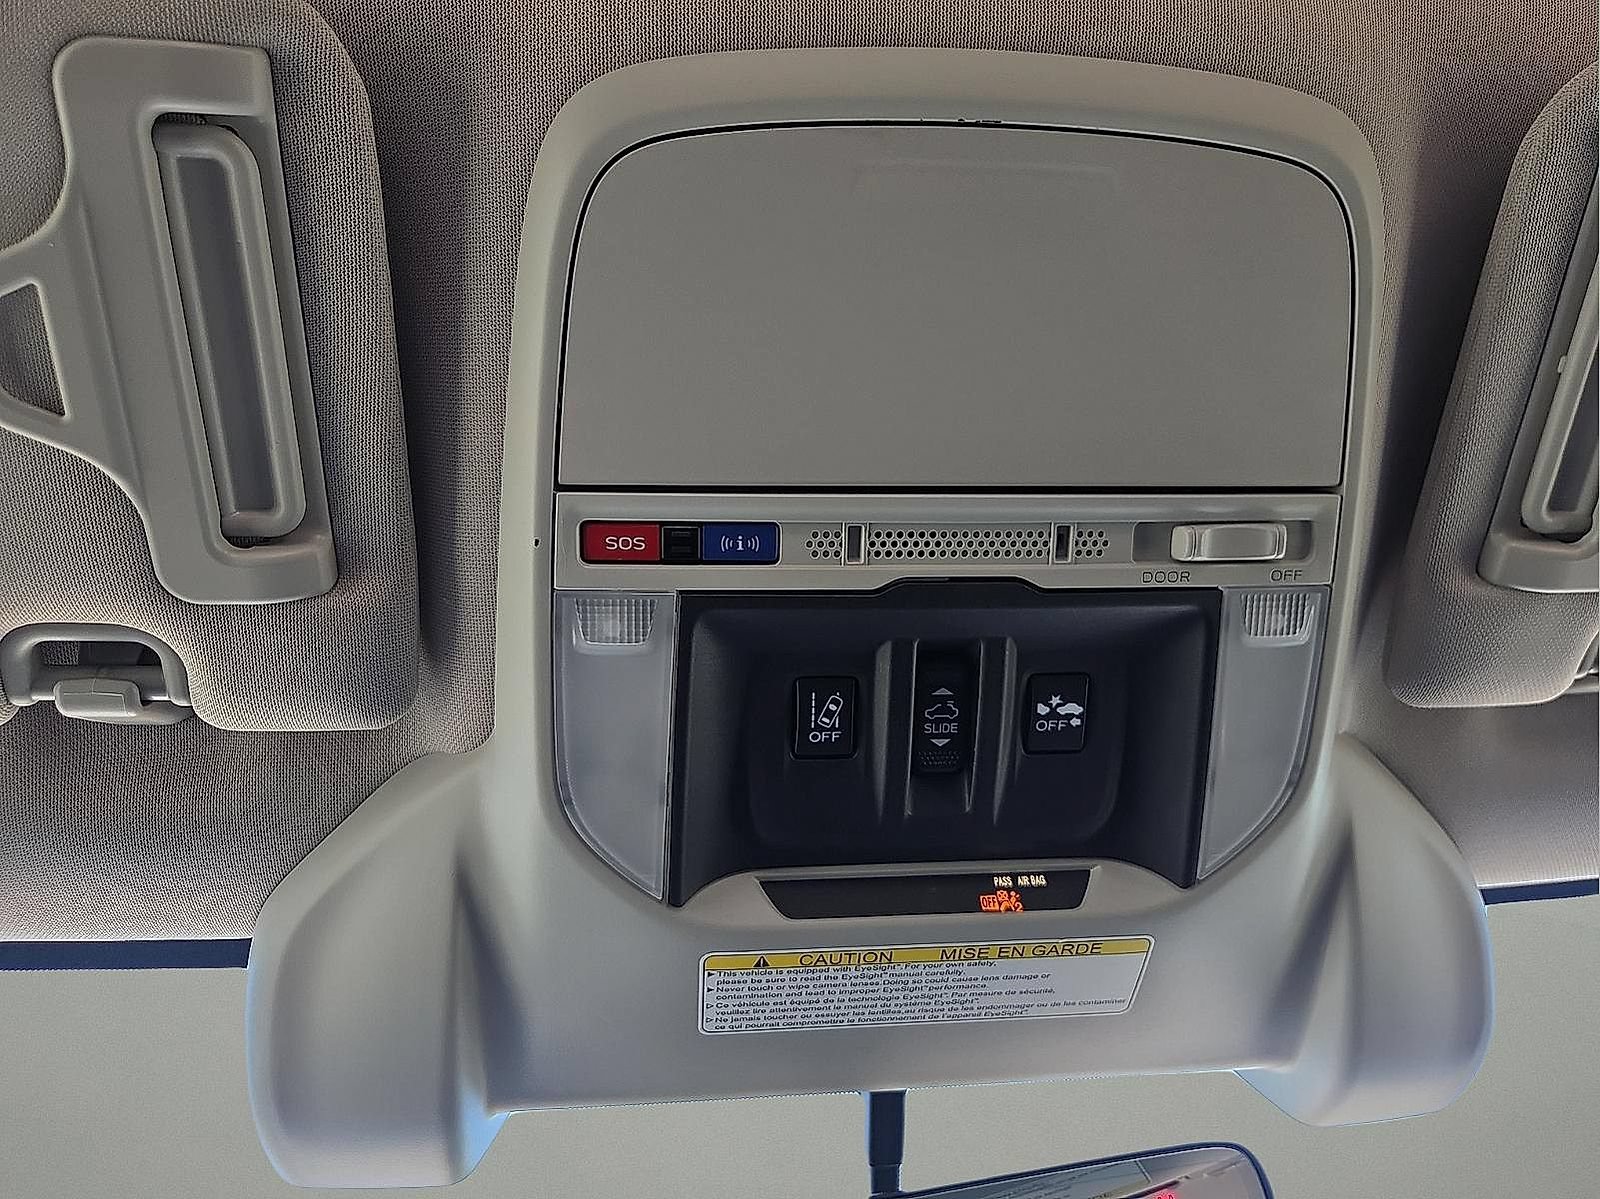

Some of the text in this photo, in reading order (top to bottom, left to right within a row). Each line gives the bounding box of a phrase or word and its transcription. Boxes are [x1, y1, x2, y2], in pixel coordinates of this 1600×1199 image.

[605, 536, 646, 550] SOS
[1142, 571, 1191, 583] DOOR
[1270, 569, 1303, 582] OFF
[924, 722, 959, 733] SLIDE
[1035, 719, 1069, 732] OFF
[809, 731, 842, 743] OFF
[993, 876, 1012, 887] PASS
[981, 896, 998, 908] OFF
[799, 942, 1104, 966] CAUTION MISE EN GARDE
[740, 969, 773, 977] vehicle
[786, 967, 829, 975] equipped
[833, 965, 852, 973] with
[800, 973, 821, 981] read
[716, 992, 783, 1000] contamination
[839, 987, 880, 995] improper
[747, 984, 774, 992] touch
[788, 983, 810, 991] wipe
[848, 993, 900, 1002] technologie
[730, 1015, 761, 1023] jamais
[763, 1013, 798, 1021] toucher
[814, 1010, 850, 1019] essuyer
[917, 1006, 945, 1014] risque
[769, 1004, 831, 1013] attentivement
[728, 1022, 743, 1030] qui
[745, 1020, 780, 1029] pourrait
[782, 1018, 844, 1027] compromettre
[857, 1013, 926, 1023] fonctionnement
